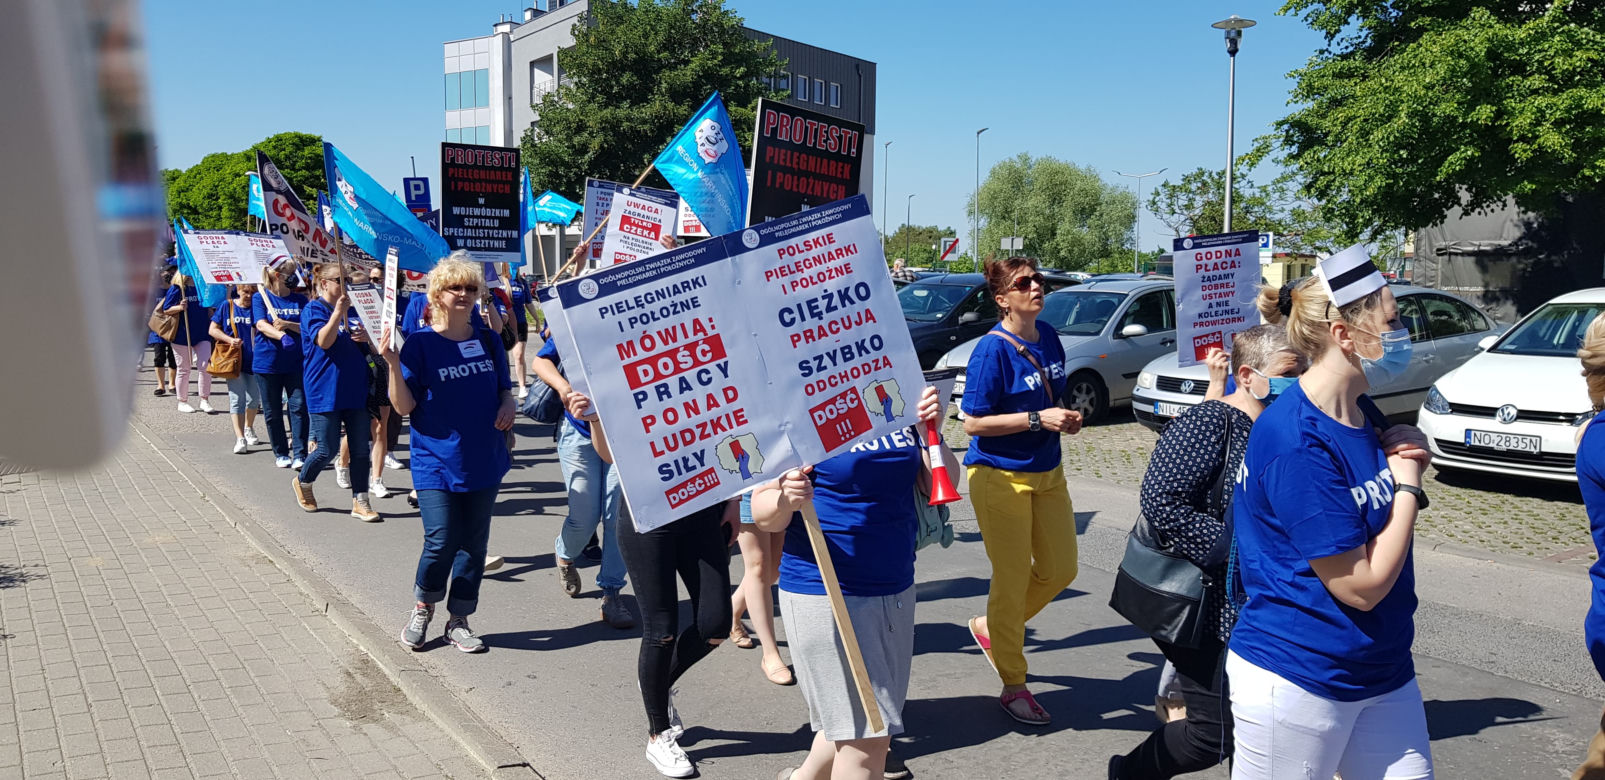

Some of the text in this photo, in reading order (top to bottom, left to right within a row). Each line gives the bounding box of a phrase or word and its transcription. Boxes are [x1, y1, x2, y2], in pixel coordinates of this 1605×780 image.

[763, 109, 859, 157] PROTEST!
[445, 147, 516, 168] PROTEST!
[676, 145, 699, 172] REGION
[765, 146, 852, 179] PIELĘGNIAREK
[448, 167, 513, 181] PIELĘGNIAREK
[766, 170, 847, 200] I POŁOŻNYCH
[409, 180, 425, 201] P
[451, 181, 511, 193] I POŁOŻNYCH
[452, 206, 510, 217] WOJEWÓDZKIM
[623, 209, 662, 223] ZAGRANICA
[626, 200, 663, 215] UWAGA!
[464, 217, 499, 227] SZPITALU
[630, 218, 652, 228] TYLKO
[760, 203, 852, 235] OGÓLNOPOLSKI ZWIĄZEK ZAWODOWY
[443, 227, 519, 238] SPECJALISTYCZNYM
[623, 224, 656, 239] CZEKA
[775, 224, 809, 238] PIELĘGNIAREK
[456, 239, 507, 248] W OLSZTYNIE
[777, 232, 836, 260] POLSKIE
[1195, 247, 1242, 262] GODNA
[599, 248, 707, 285] OGÓLNOPOLSKI ZWIĄZEK ZAWODOWY
[616, 272, 657, 287] PIELĘGNIAREK
[660, 258, 696, 274] POŁOŻNYCH
[764, 243, 858, 282] PIELĘGNIARKI
[1195, 261, 1241, 274] PŁACA:
[782, 262, 853, 295] I POŁOŻNE
[1201, 272, 1235, 284] ŻĄDAMY
[1201, 282, 1236, 292] DOBREJ
[599, 275, 708, 319] PIELĘGNIARKI
[778, 281, 871, 328] CIĘŻKO
[1202, 291, 1236, 301] USTAWY
[1216, 300, 1230, 308] NIE
[618, 296, 702, 332] I POŁOŻNE
[1193, 316, 1245, 328] PROWIZORKI
[1197, 307, 1240, 319] KOLEJNEJ
[616, 316, 717, 361] MÓWIĄ:
[790, 308, 877, 349] PRACUJĄ
[1194, 334, 1221, 347] DOŚĆ
[636, 340, 713, 384] DOŚĆ
[798, 334, 884, 377] SZYBKO
[438, 359, 494, 381] PROTES
[804, 355, 893, 396] ODCHODZĄ
[633, 360, 730, 410] PRACY
[641, 385, 739, 434] PONAD
[813, 391, 859, 426] DOŚĆ
[1158, 403, 1174, 415] NIL
[649, 407, 749, 458] LUDZKIE
[836, 419, 855, 441] !!!
[1473, 432, 1538, 451] NO 2835N
[658, 449, 706, 482] SIŁY
[669, 472, 719, 505] DOŚĆ!!!
